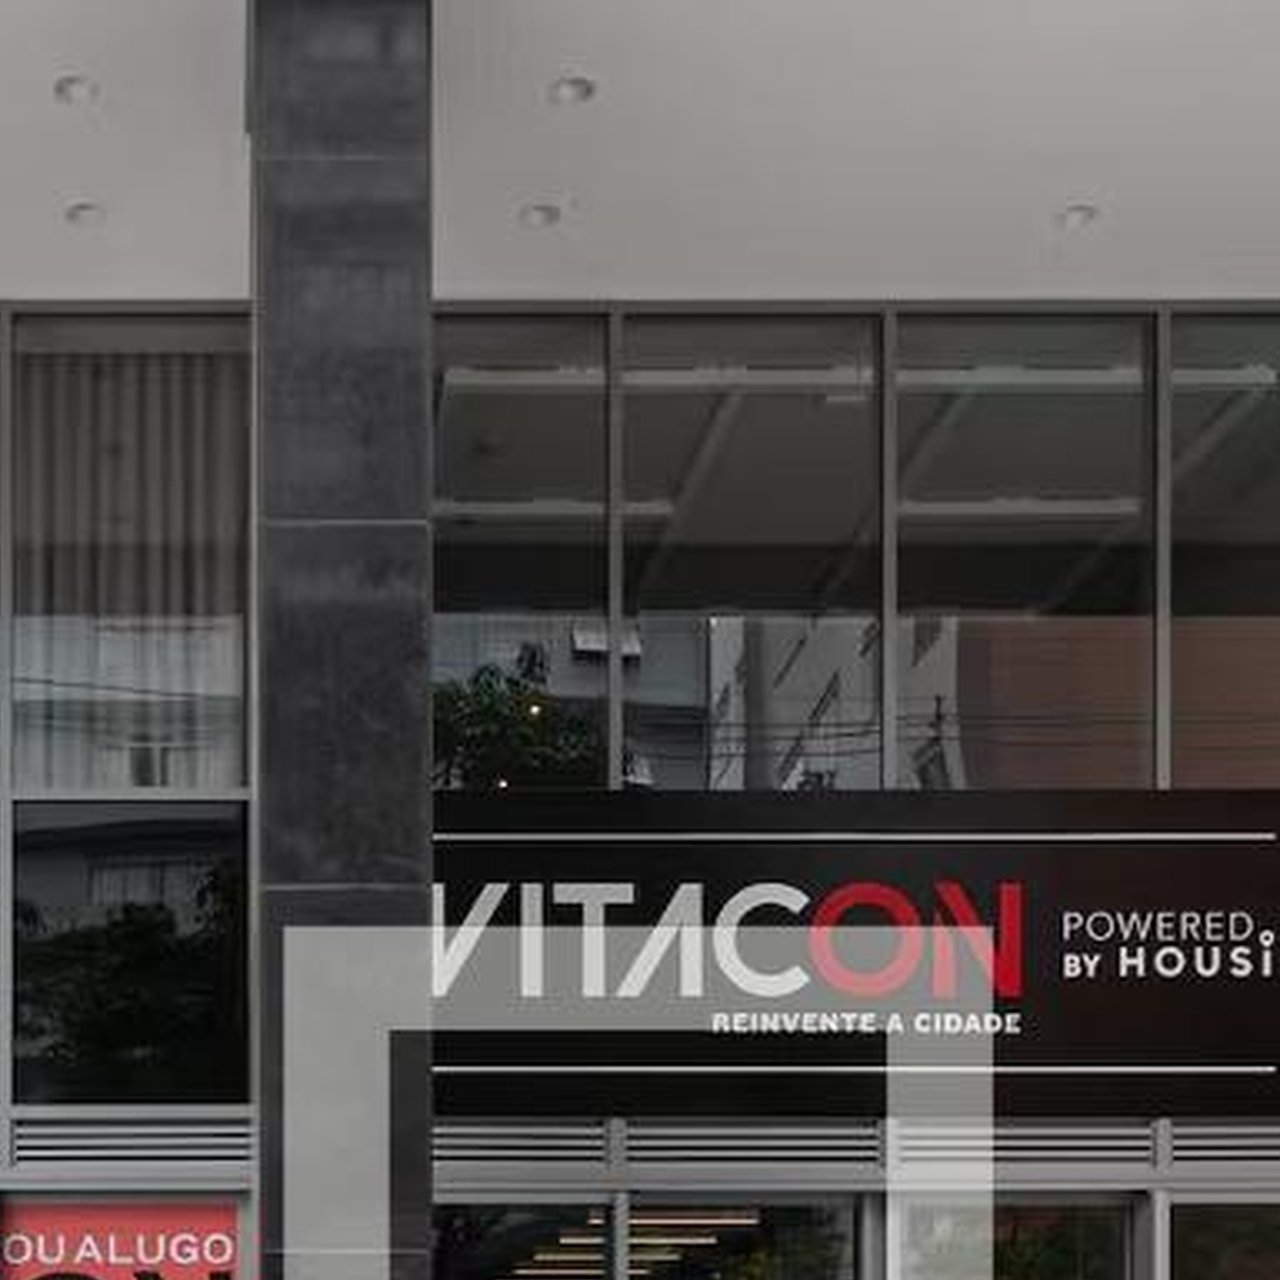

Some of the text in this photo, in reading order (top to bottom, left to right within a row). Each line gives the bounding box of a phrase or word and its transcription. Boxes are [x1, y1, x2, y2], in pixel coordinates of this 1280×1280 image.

[432, 882, 1023, 998] VITACON
[1062, 912, 1254, 941] POWERED
[1063, 954, 1101, 978] BY
[711, 1012, 1021, 1033] REINVENTE A CIDADE
[4, 1233, 65, 1265] OU
[74, 1233, 233, 1265] ALUGO
